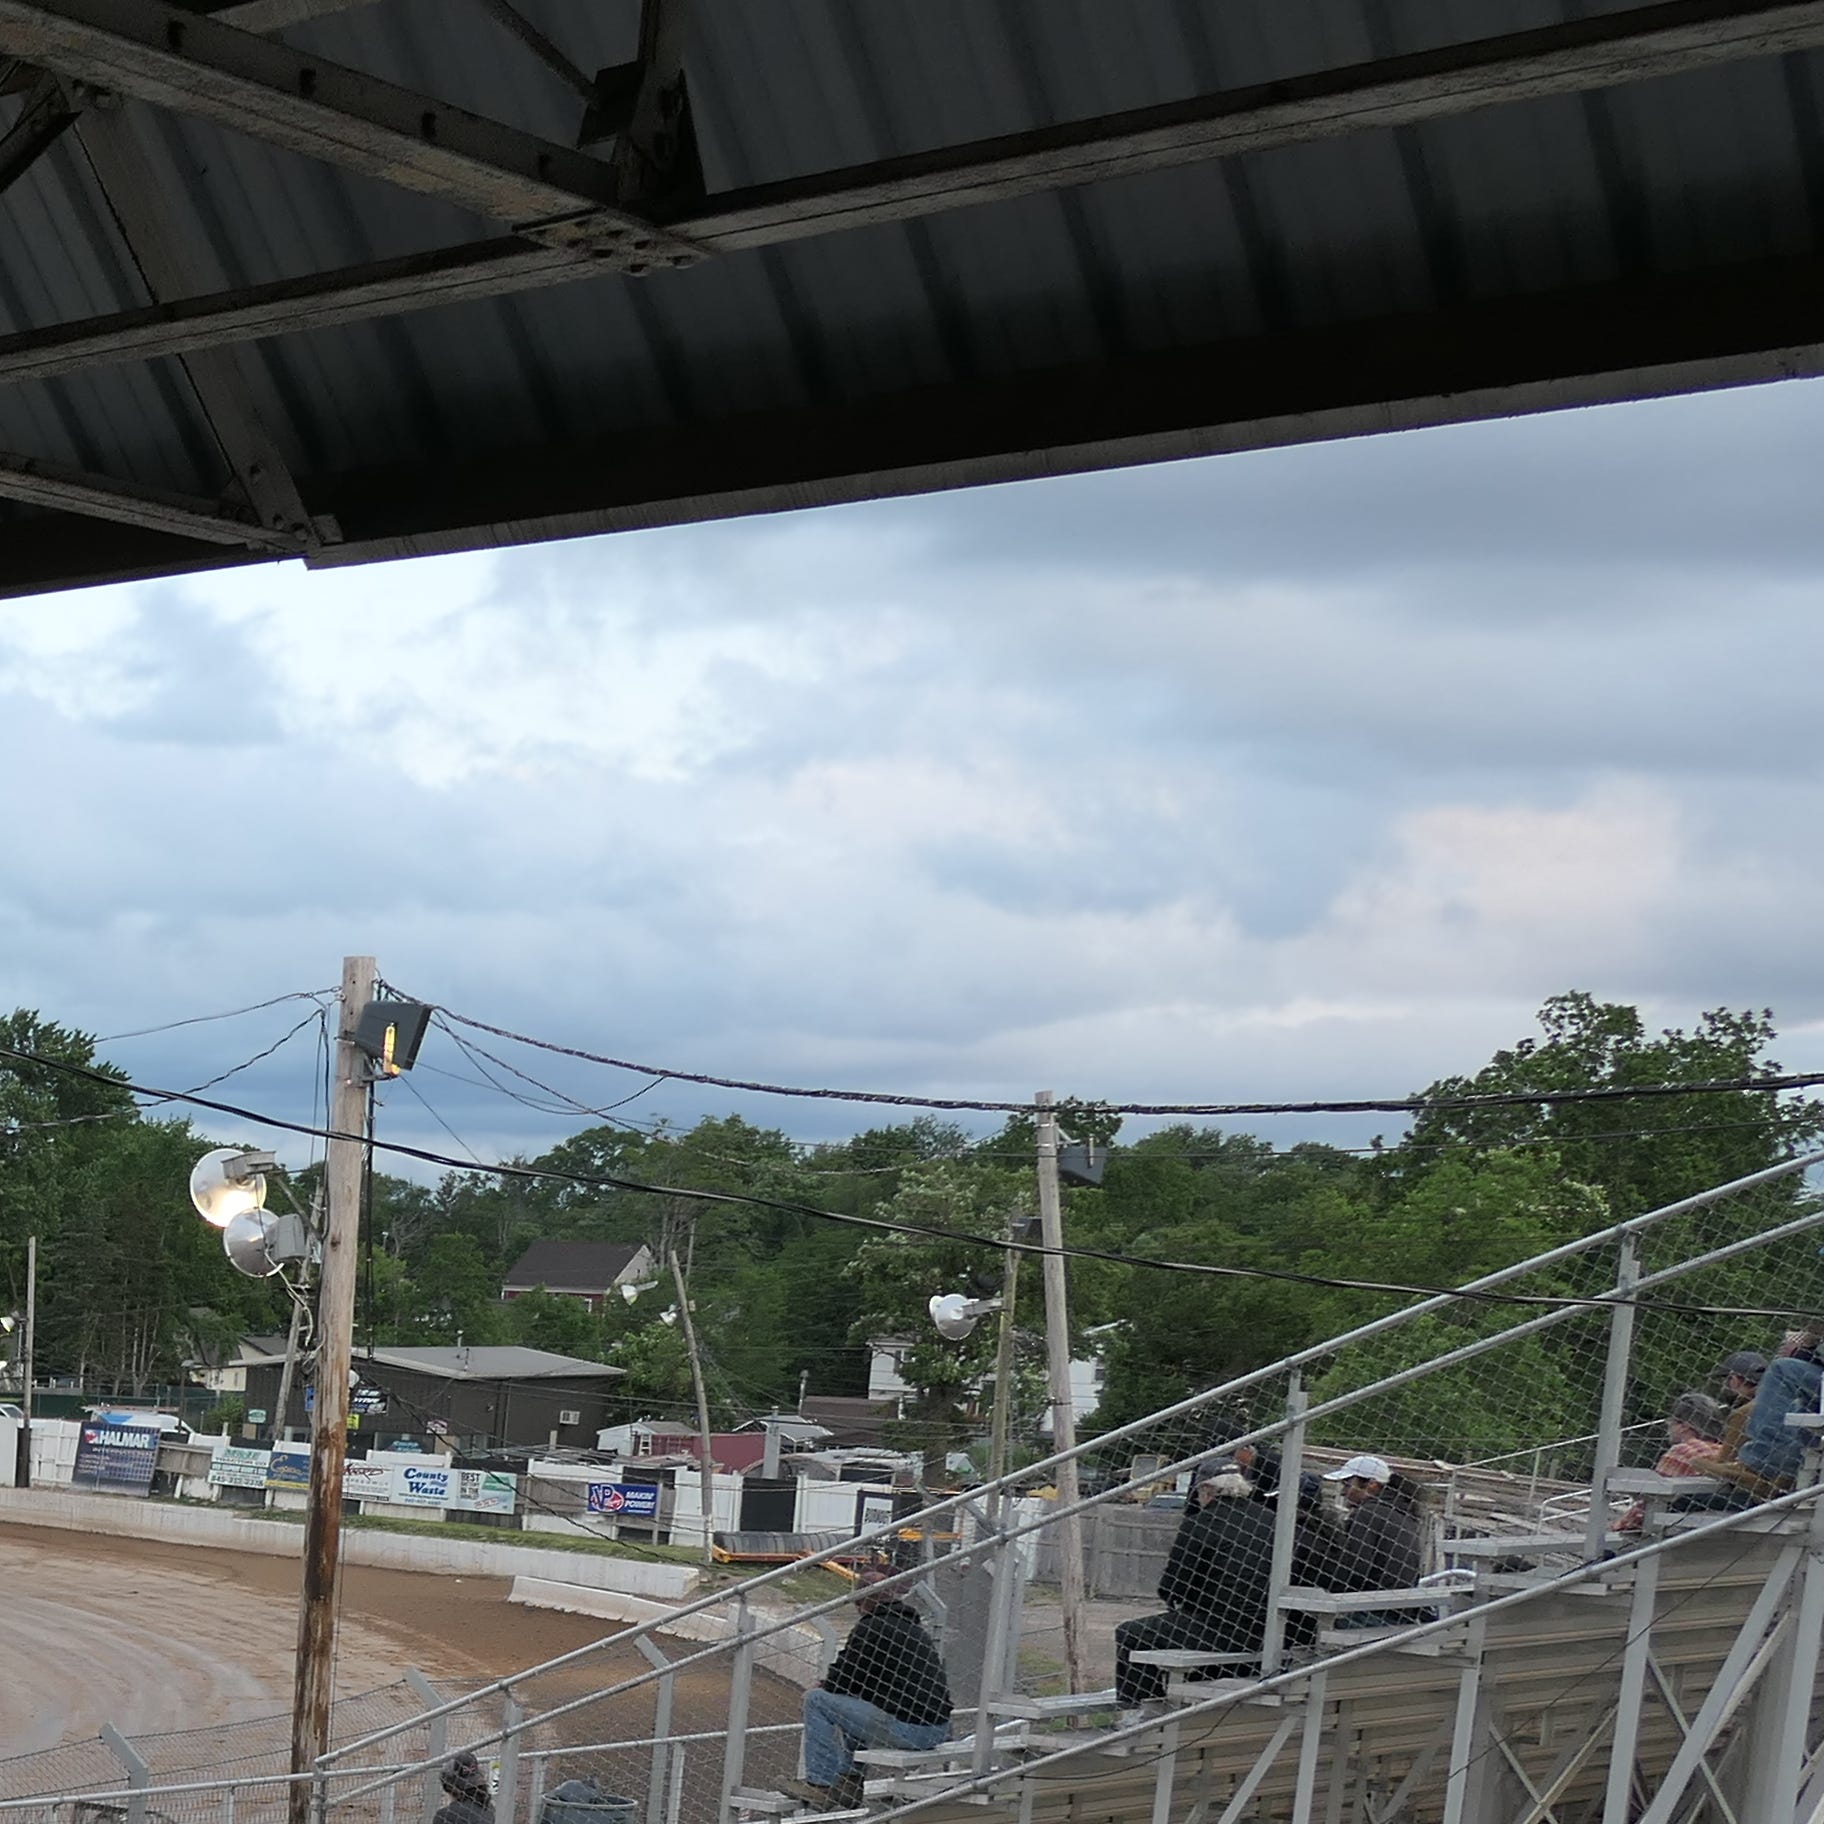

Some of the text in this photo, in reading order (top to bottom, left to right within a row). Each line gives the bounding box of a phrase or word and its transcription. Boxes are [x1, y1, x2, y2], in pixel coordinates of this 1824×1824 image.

[100, 1430, 149, 1448] HALMAR
[404, 1468, 448, 1481] County
[409, 1482, 445, 1495] Waste
